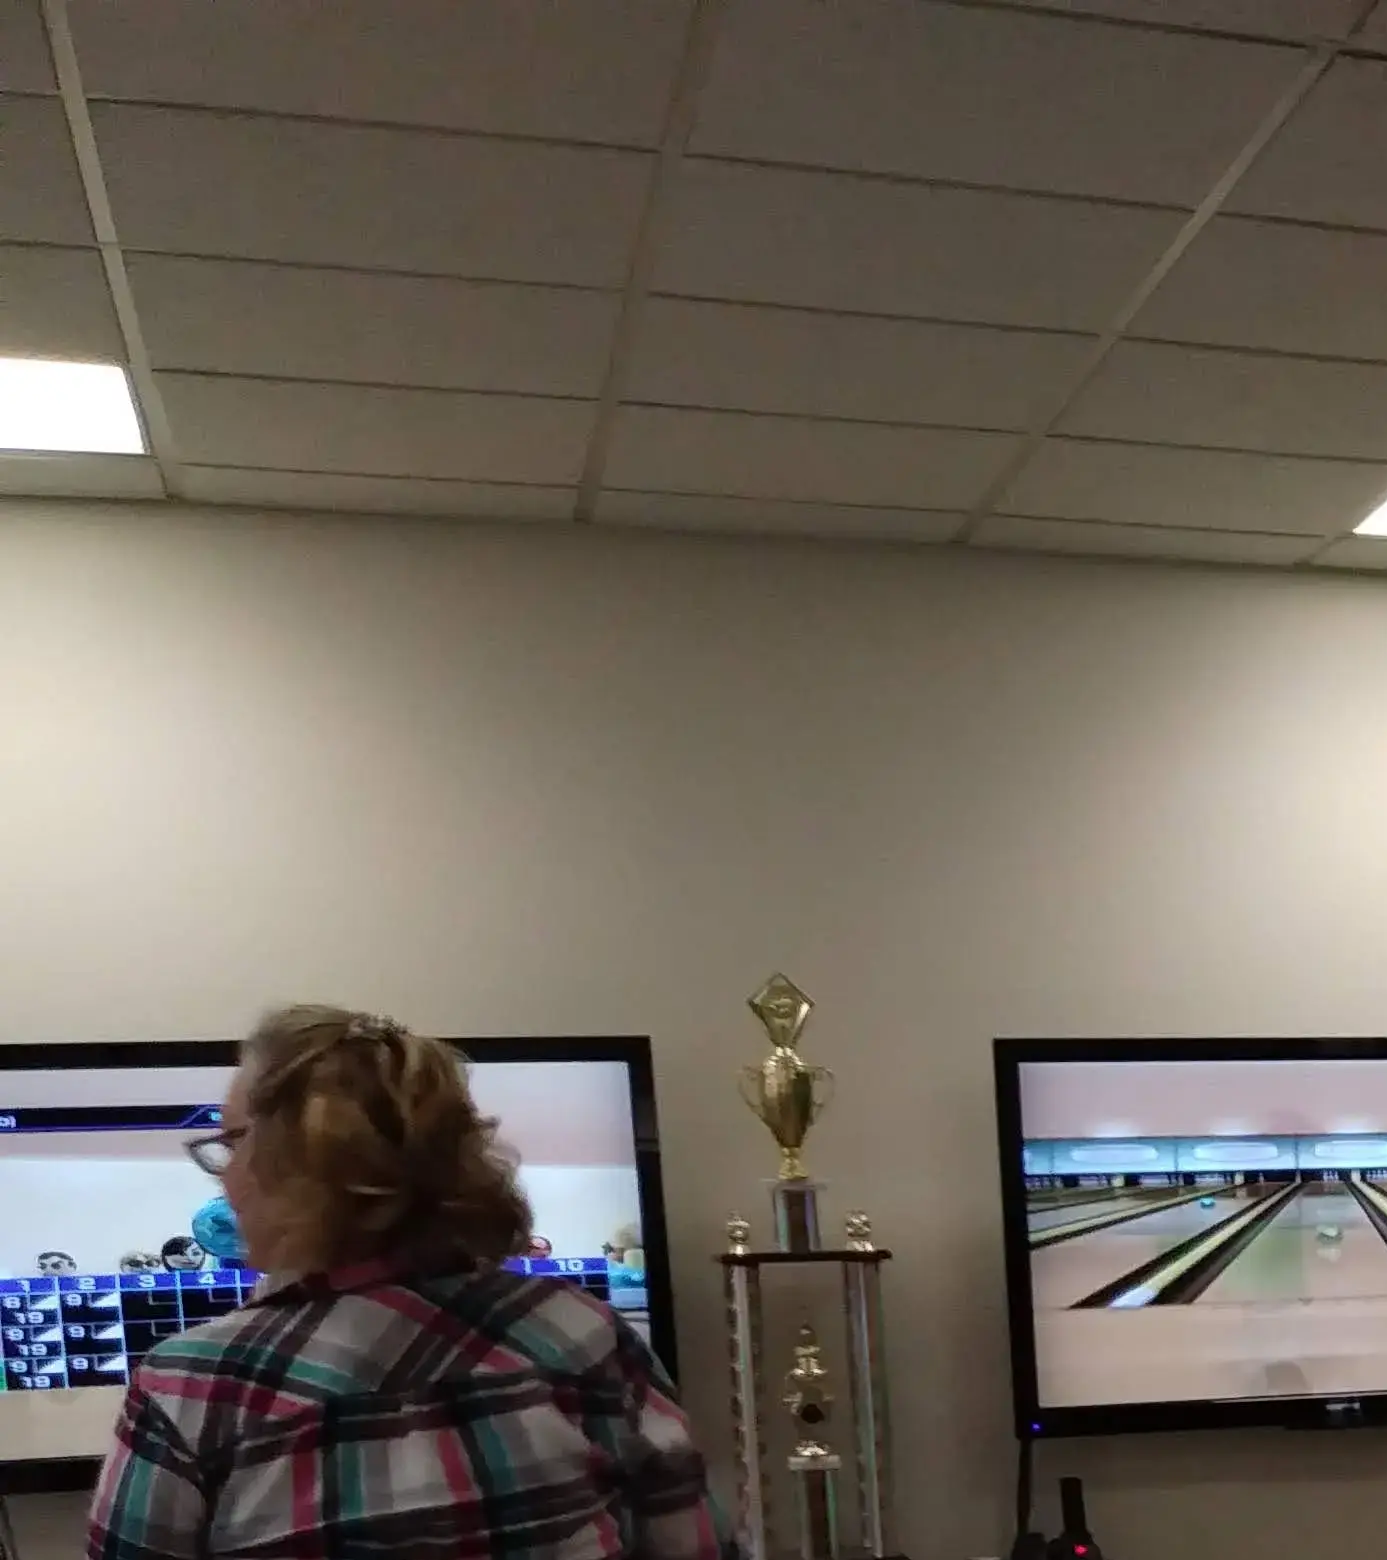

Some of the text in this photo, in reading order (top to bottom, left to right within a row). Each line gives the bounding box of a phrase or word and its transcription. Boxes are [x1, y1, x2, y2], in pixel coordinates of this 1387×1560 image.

[78, 1277, 96, 1290] 2
[139, 1274, 156, 1287] 3
[198, 1271, 216, 1285] 4
[555, 1258, 584, 1272] 10
